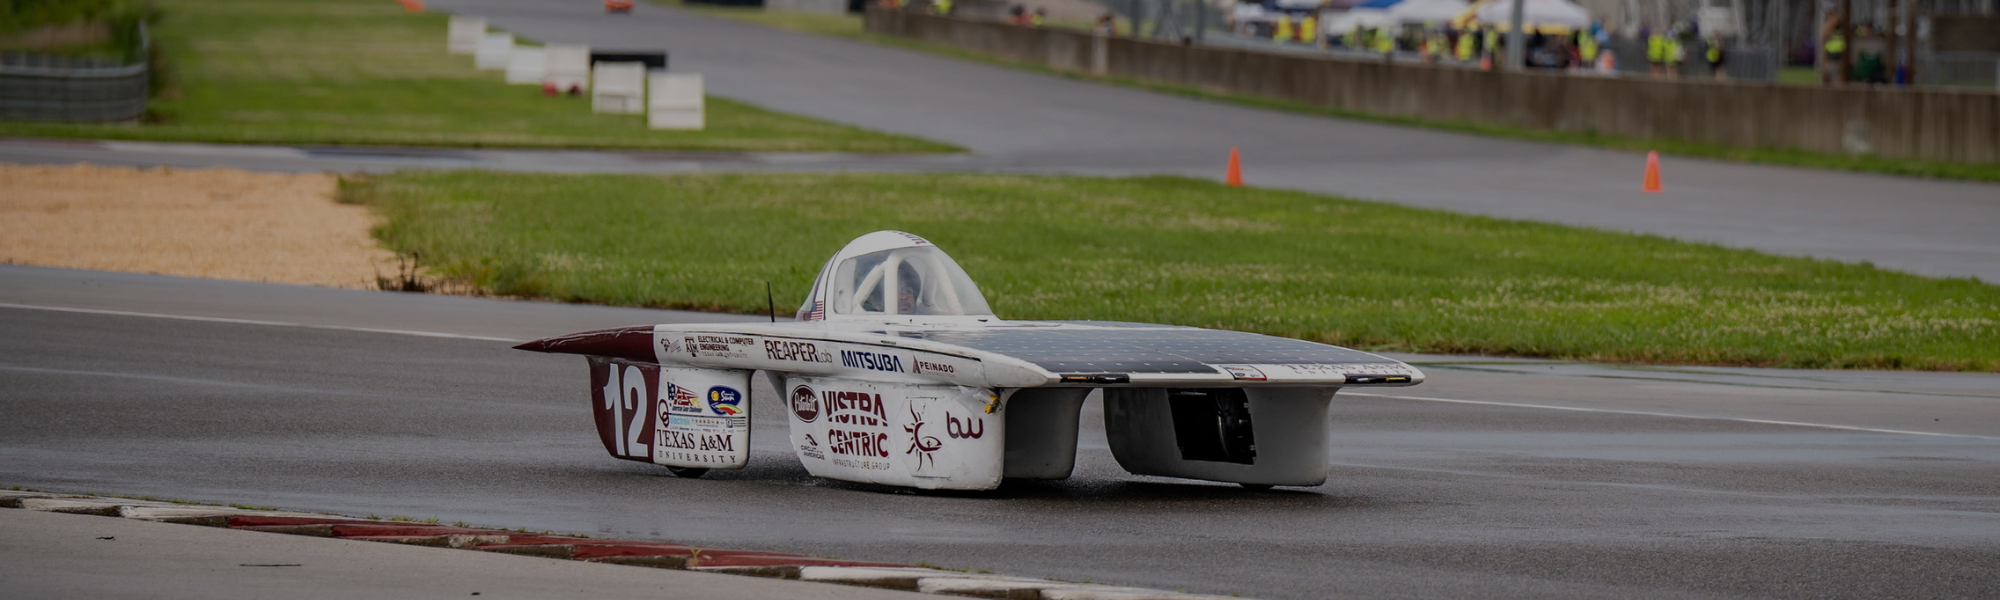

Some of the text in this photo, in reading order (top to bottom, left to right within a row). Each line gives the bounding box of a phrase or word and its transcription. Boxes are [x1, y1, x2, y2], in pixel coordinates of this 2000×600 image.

[697, 335, 725, 344] ELECTRICAL
[729, 337, 755, 346] COMPUTER
[699, 343, 730, 352] ENGINEERING
[840, 349, 905, 374] MITSUBA
[919, 361, 955, 374] PEINADO
[603, 363, 649, 458] 12
[821, 390, 888, 427] VISTRA
[656, 429, 734, 451] TEXAS A&M
[828, 428, 890, 458] CENTRIC
[659, 451, 736, 463] UNIVERSITY
[832, 458, 891, 471] INFRASTRUCTURE GROUP
